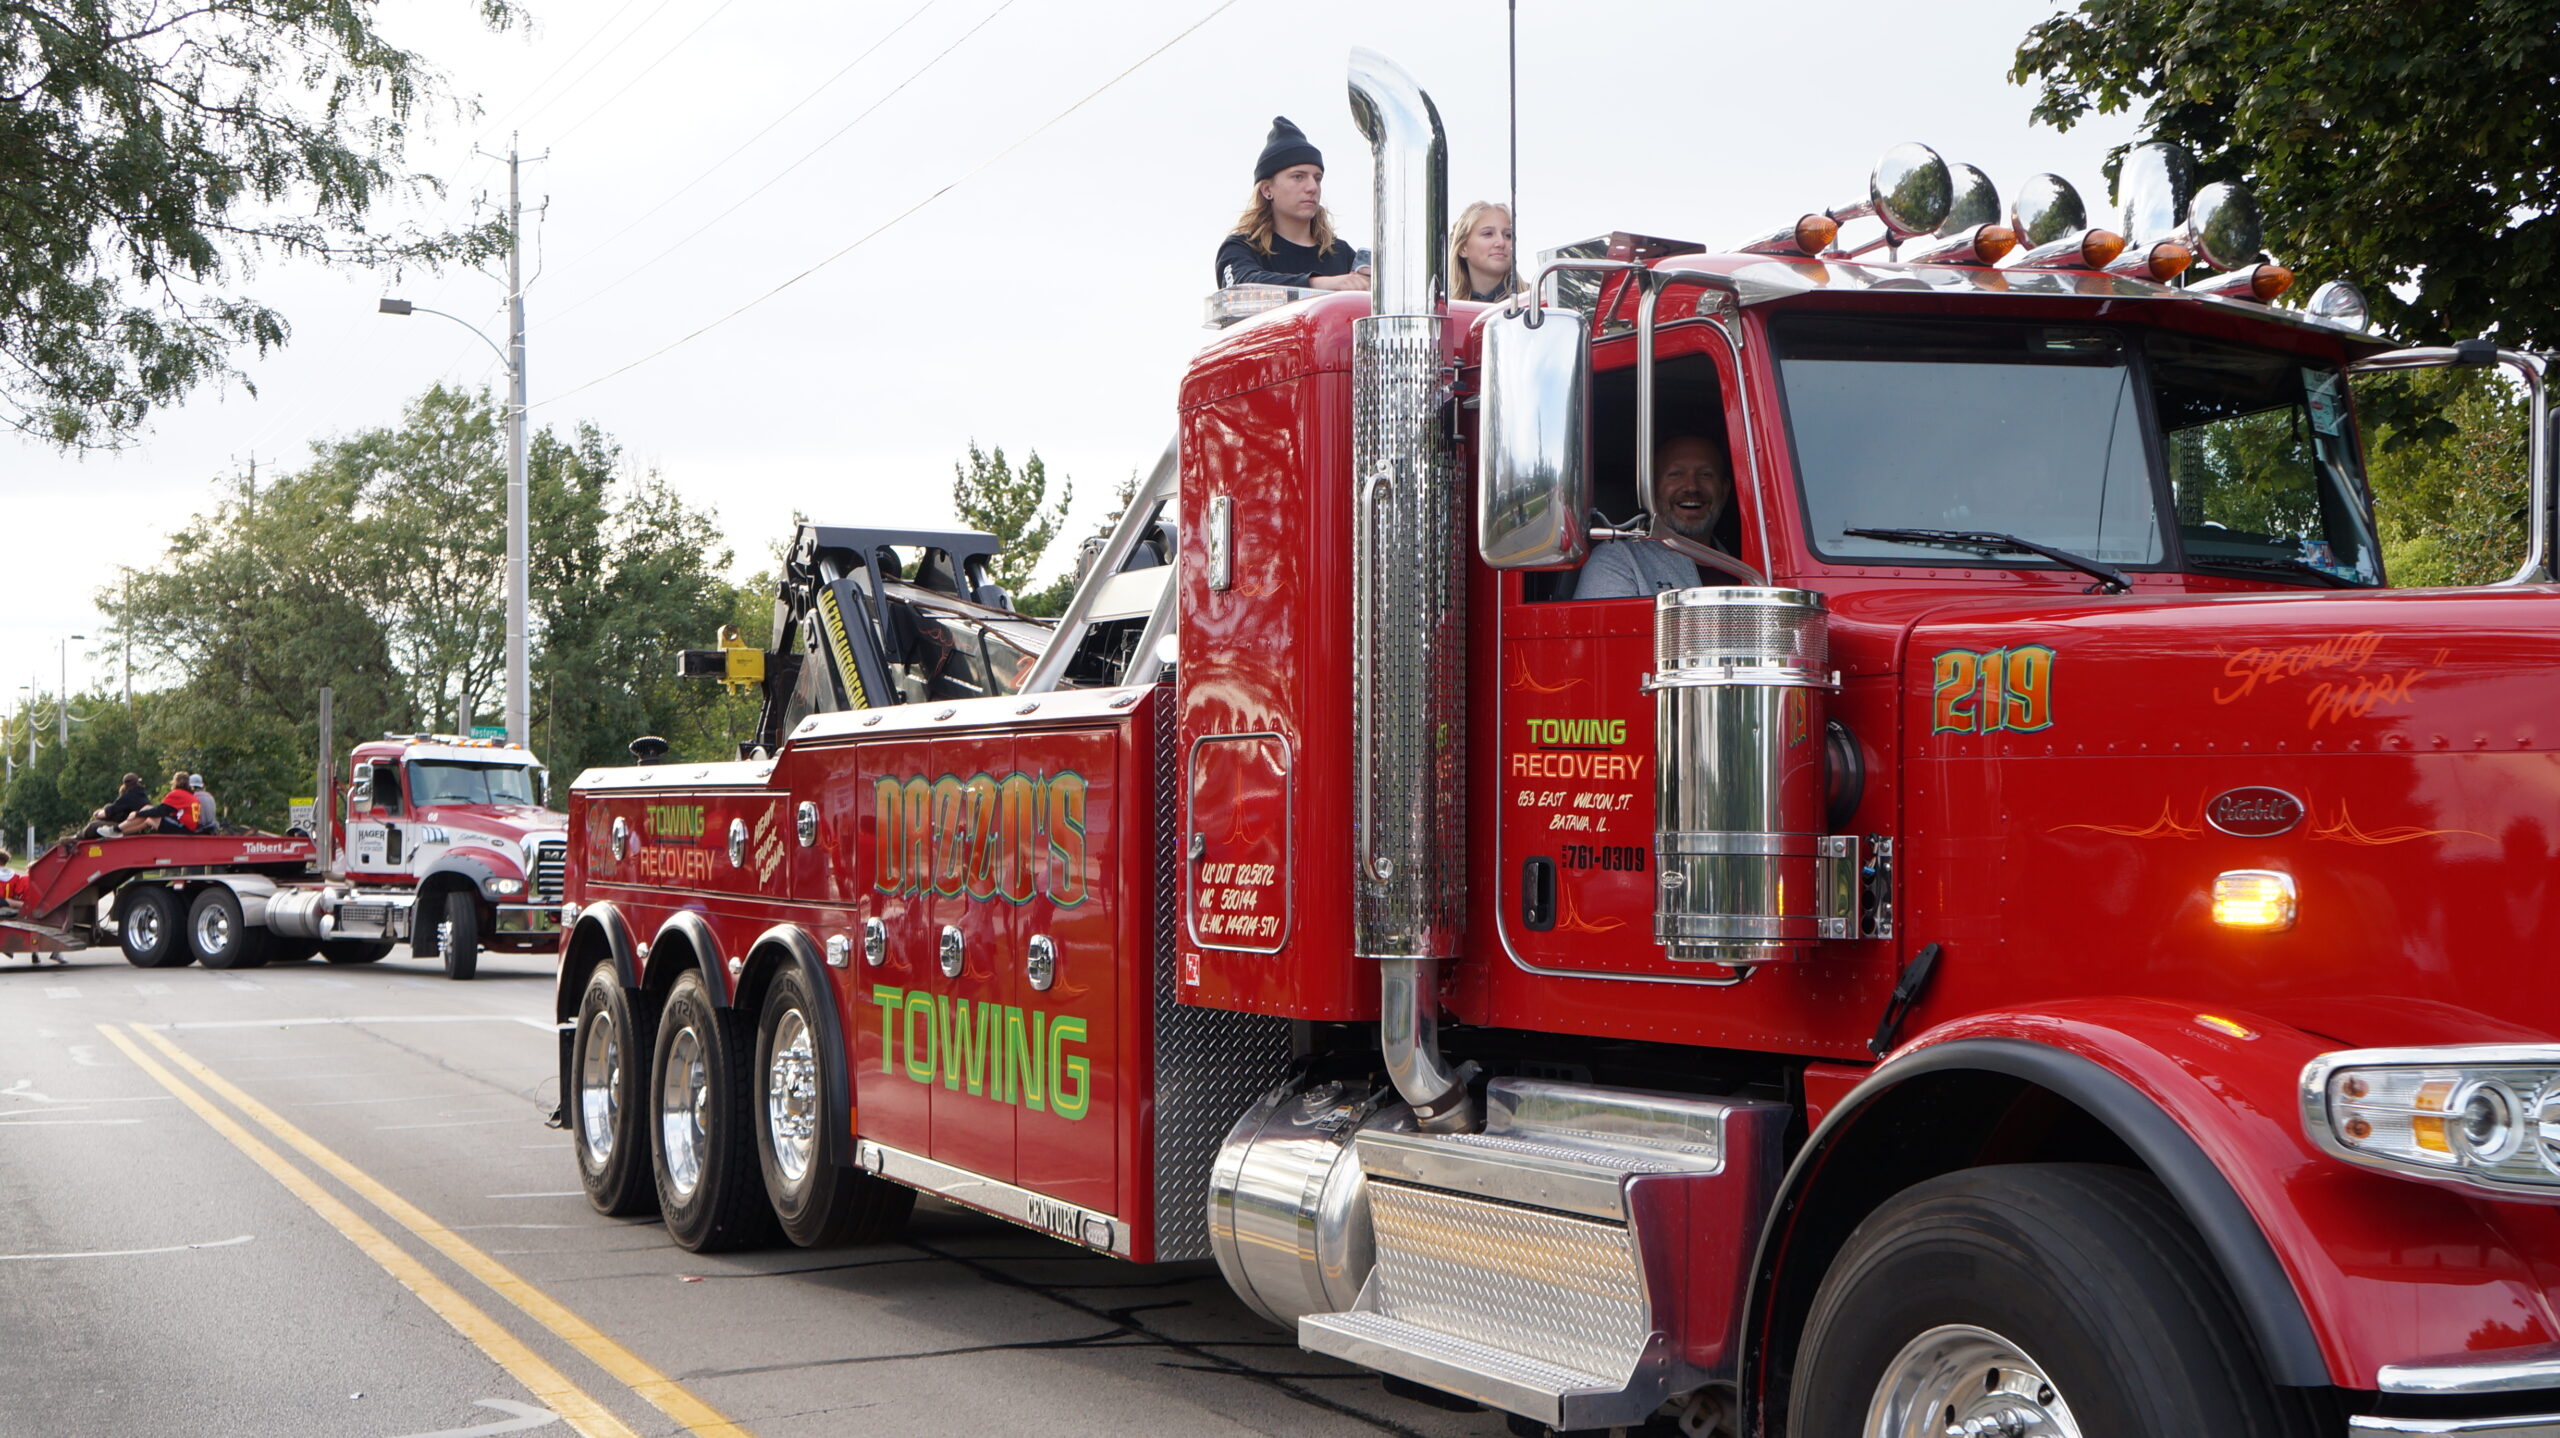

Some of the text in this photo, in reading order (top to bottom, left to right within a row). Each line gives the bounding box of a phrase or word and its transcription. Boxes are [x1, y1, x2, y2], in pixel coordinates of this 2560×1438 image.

[1932, 646, 2056, 737] 219
[1527, 719, 1627, 745] TOWING
[1512, 753, 1644, 780] RECOVERY
[1518, 790, 1535, 806] 853
[1538, 791, 1567, 807] EAST
[1614, 794, 1633, 810] ST.
[2217, 797, 2294, 823] Peterbilt
[647, 805, 705, 837] TOWING
[243, 842, 282, 853] Talbert
[359, 830, 385, 841] HAGER
[874, 768, 1089, 910] DAZZO'S
[640, 847, 715, 881] RECOVERY
[1567, 844, 1645, 872] 761-0309
[1201, 863, 1216, 882] US
[1215, 863, 1235, 885] DOT
[872, 984, 1091, 1122] TOWING
[1026, 1196, 1080, 1239] CENTURY
